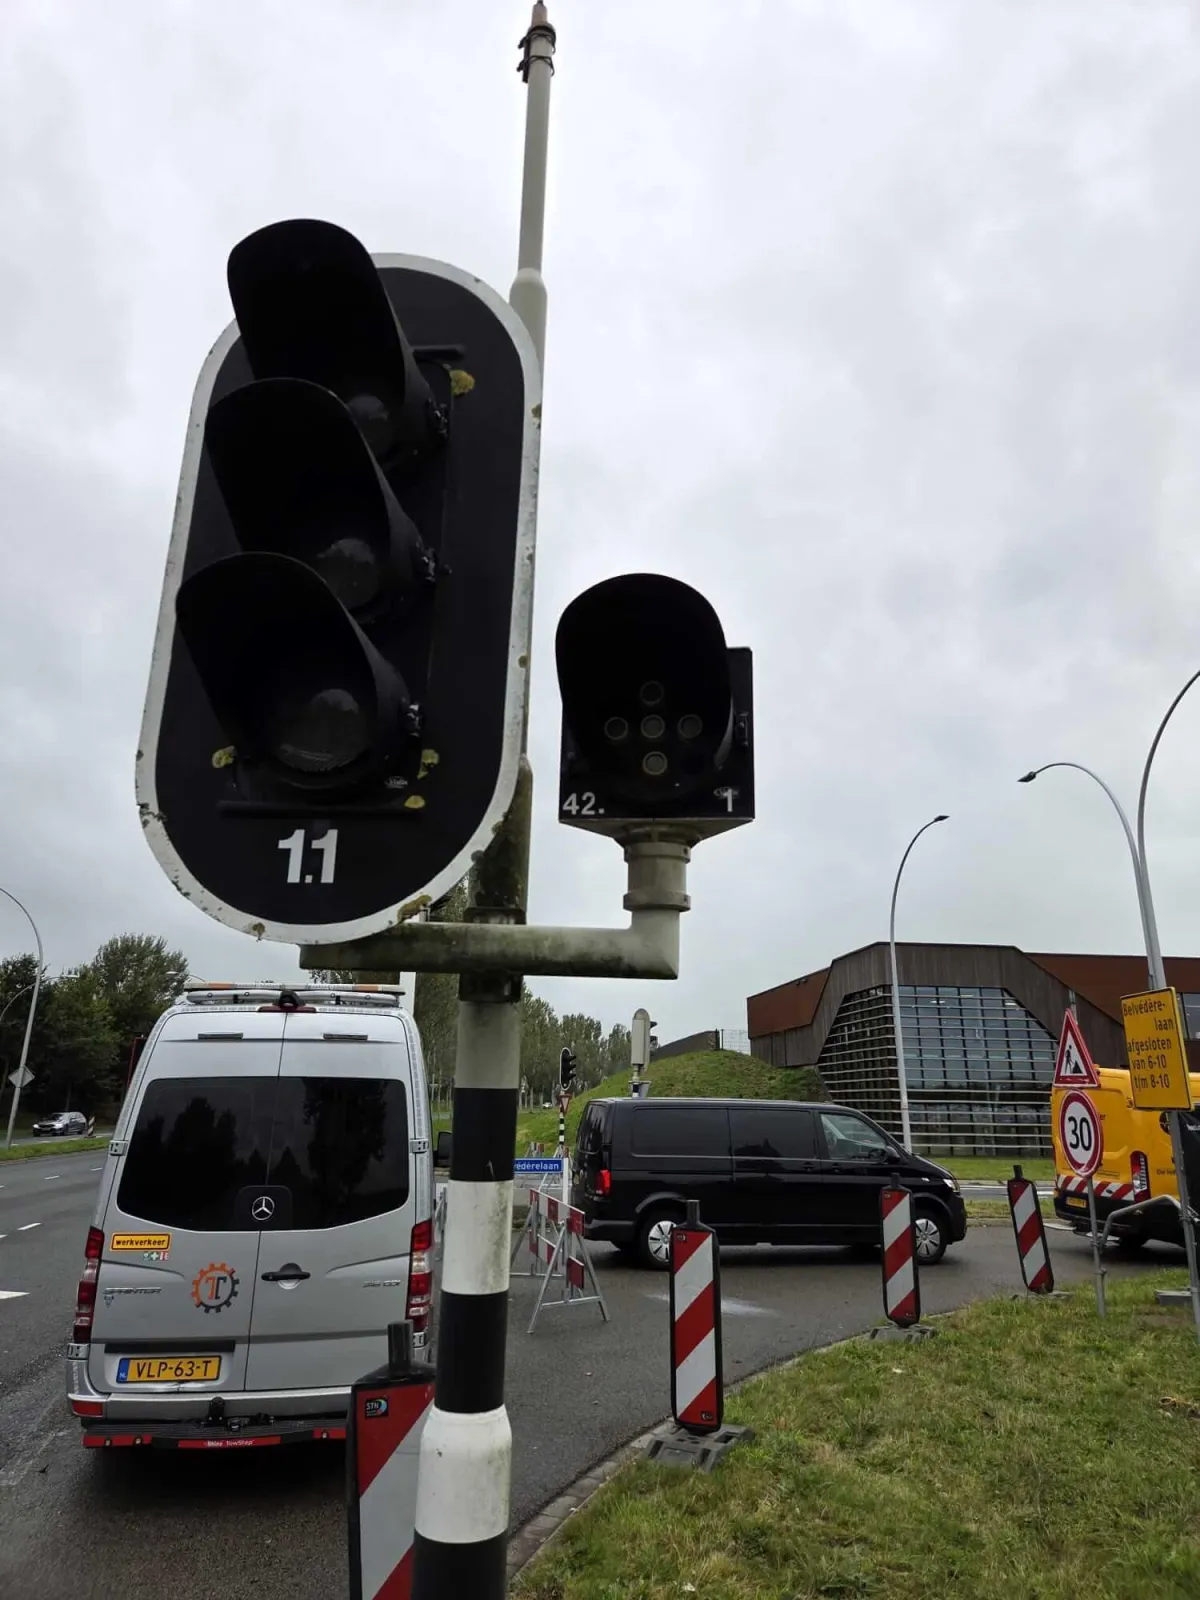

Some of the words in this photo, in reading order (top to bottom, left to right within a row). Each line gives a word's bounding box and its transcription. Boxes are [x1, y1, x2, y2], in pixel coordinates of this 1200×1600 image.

[723, 788, 733, 812] 1
[278, 829, 338, 883] 1.1
[1154, 1017, 1175, 1031] laan
[1127, 1037, 1172, 1056] afgesloten
[1132, 1058, 1146, 1070] van
[1147, 1054, 1167, 1069] 6-10
[1134, 1074, 1149, 1091] t/m
[1150, 1074, 1170, 1088] 8-10
[1067, 1115, 1093, 1152] 30
[115, 1238, 166, 1247] werkverkeer
[136, 1360, 212, 1378] VLP-63-T
